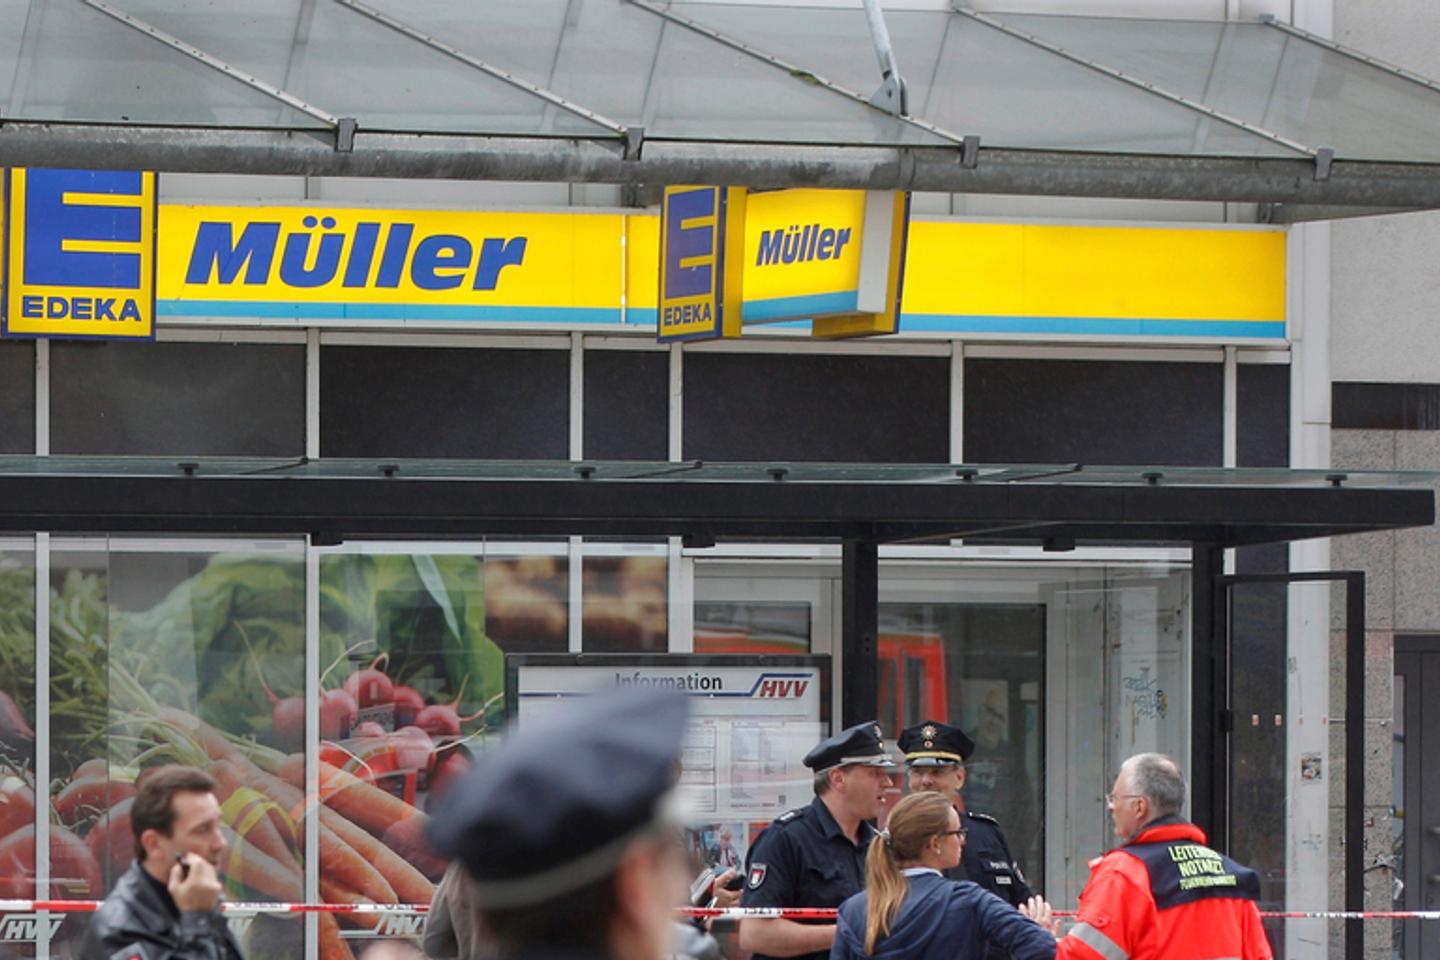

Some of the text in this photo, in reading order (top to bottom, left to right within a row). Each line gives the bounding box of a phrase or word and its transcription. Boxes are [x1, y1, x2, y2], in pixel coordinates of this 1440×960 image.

[185, 215, 528, 291] Müller
[756, 224, 851, 266] Müller
[22, 295, 142, 321] EDEKA
[664, 303, 712, 327] EDEKA
[615, 672, 808, 698] Information HVV
